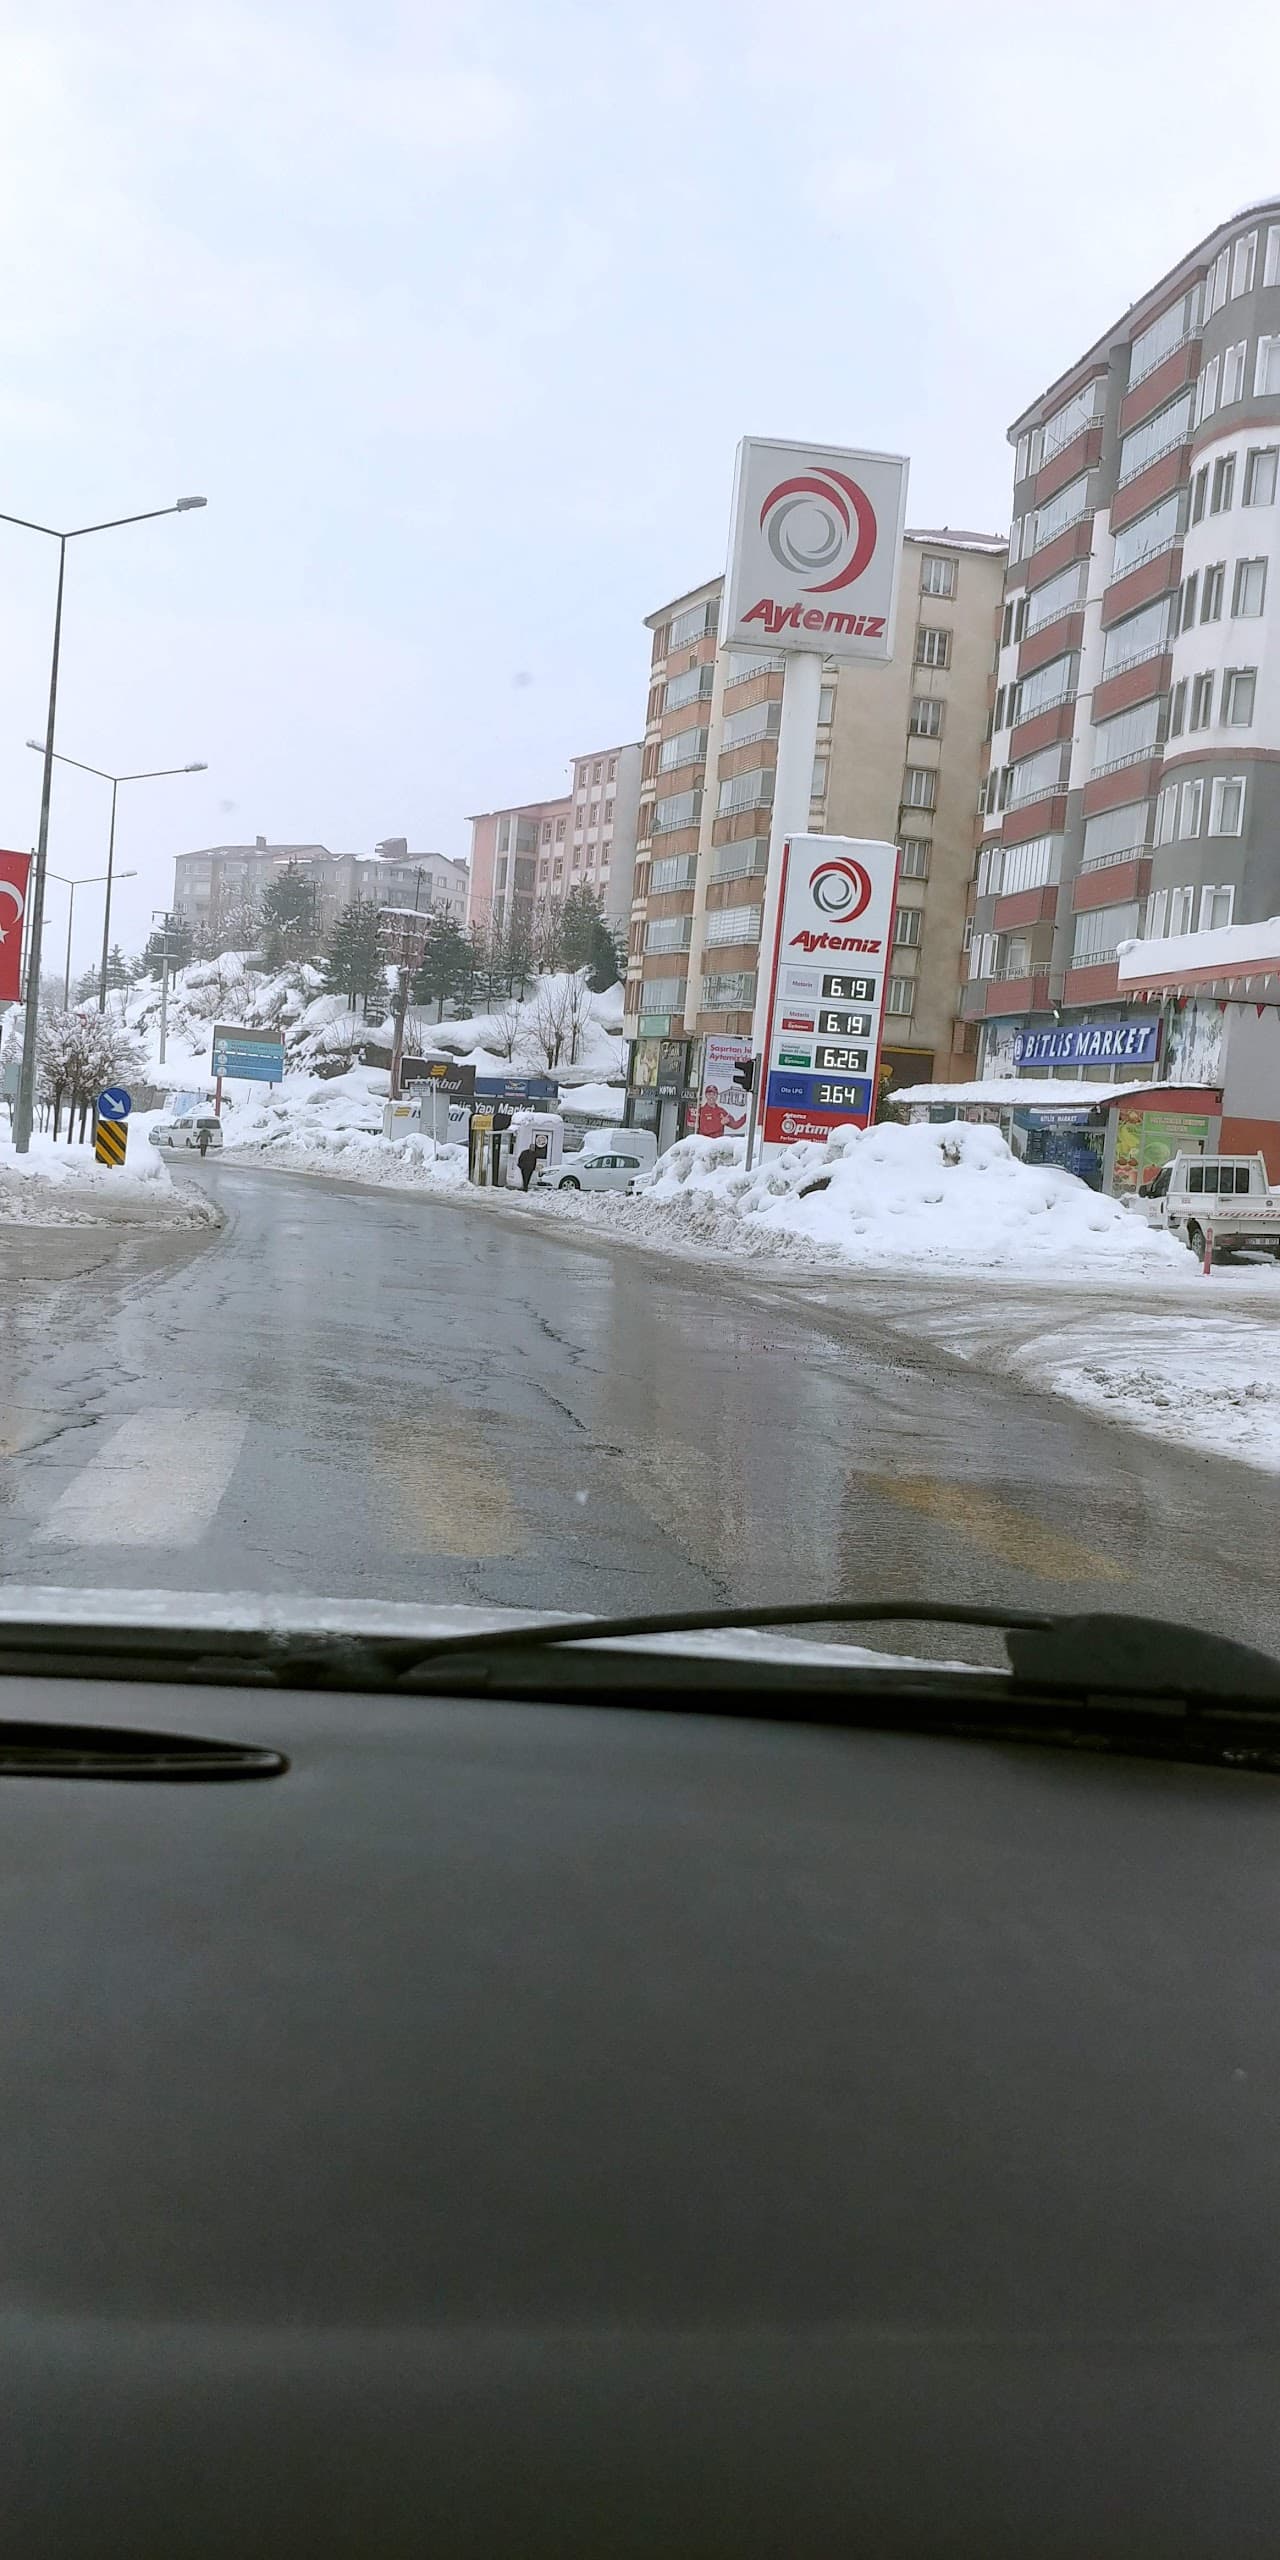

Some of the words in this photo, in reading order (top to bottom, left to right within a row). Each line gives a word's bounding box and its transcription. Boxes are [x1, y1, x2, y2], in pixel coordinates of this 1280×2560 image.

[740, 598, 887, 638] Aytemiz
[788, 930, 882, 954] Aytemiz
[830, 978, 867, 999] 6.19
[827, 1014, 863, 1034] 6.19
[1075, 1027, 1151, 1056] MARKET
[823, 1049, 859, 1069] 6.26
[820, 1084, 856, 1104] 3.64
